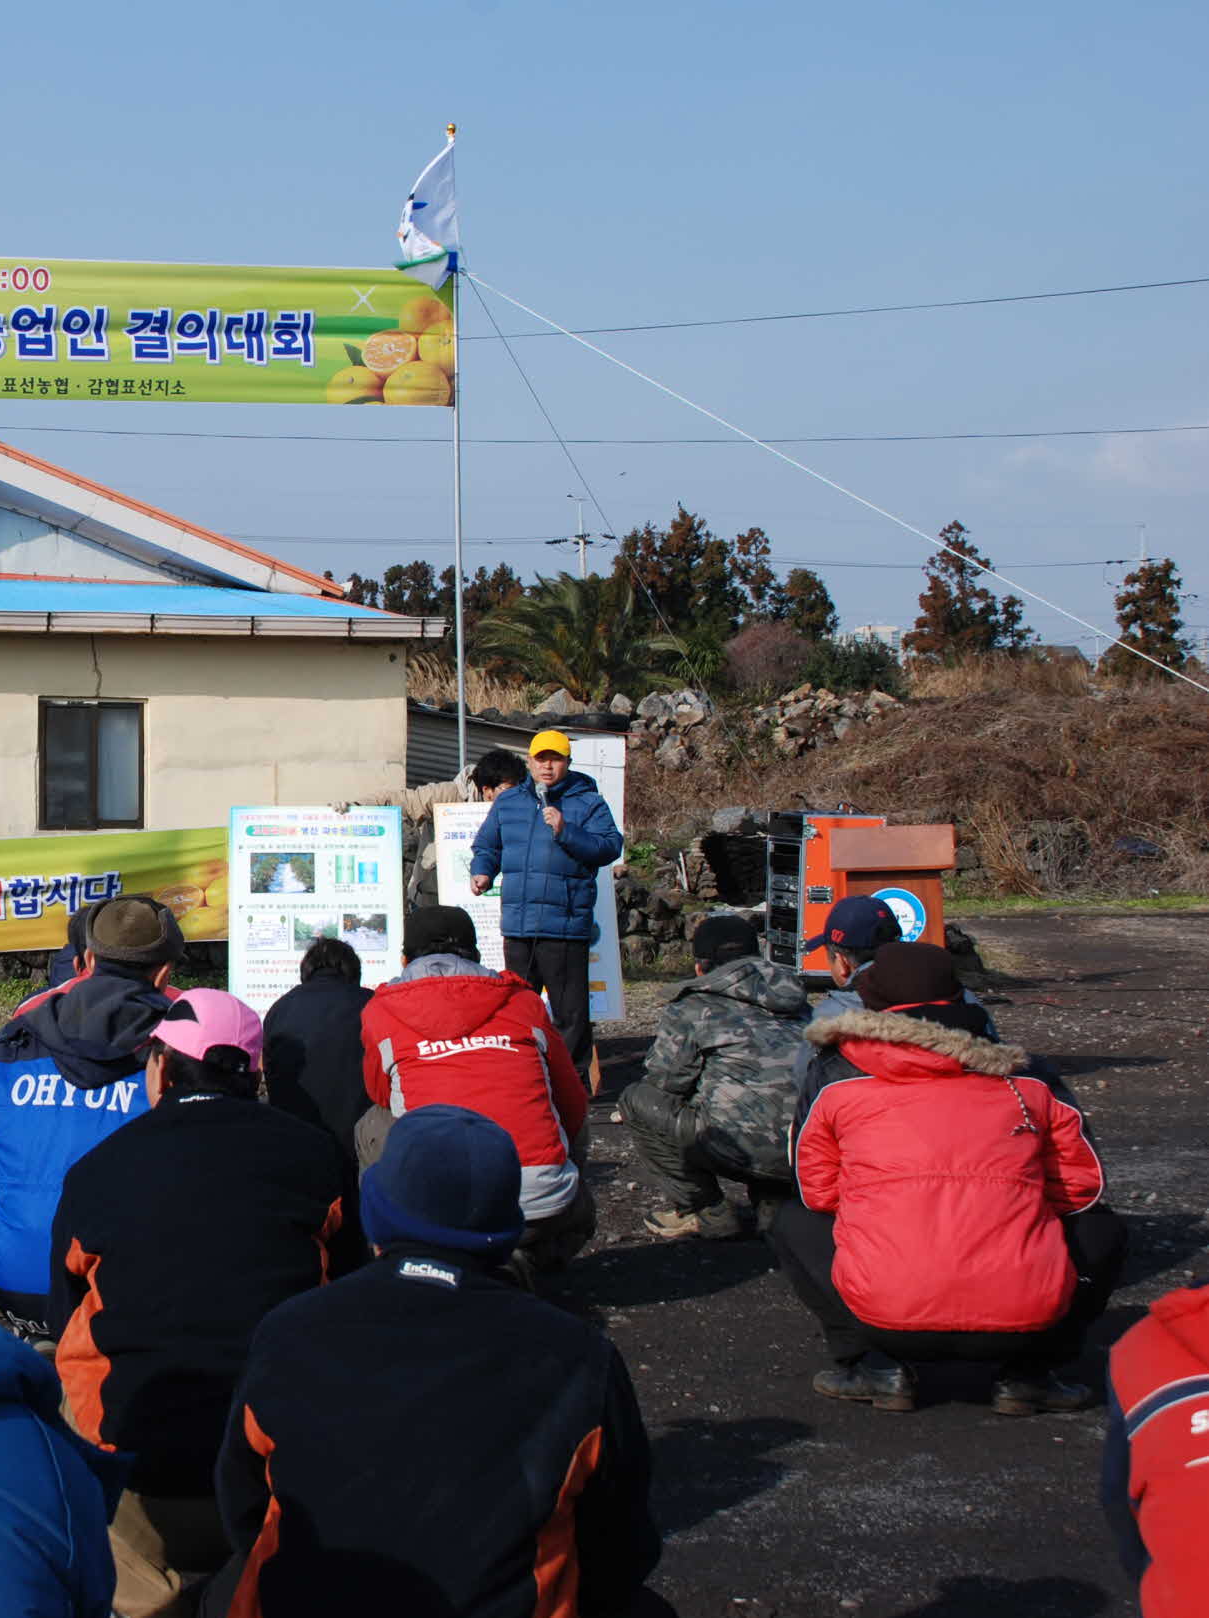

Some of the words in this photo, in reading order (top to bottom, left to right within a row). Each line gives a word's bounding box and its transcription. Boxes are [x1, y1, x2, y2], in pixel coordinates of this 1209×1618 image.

[125, 310, 311, 363] 결의대회
[1, 376, 69, 394] 표선농협
[87, 379, 186, 396] 감협표선지소
[402, 1261, 455, 1281] EnClean
